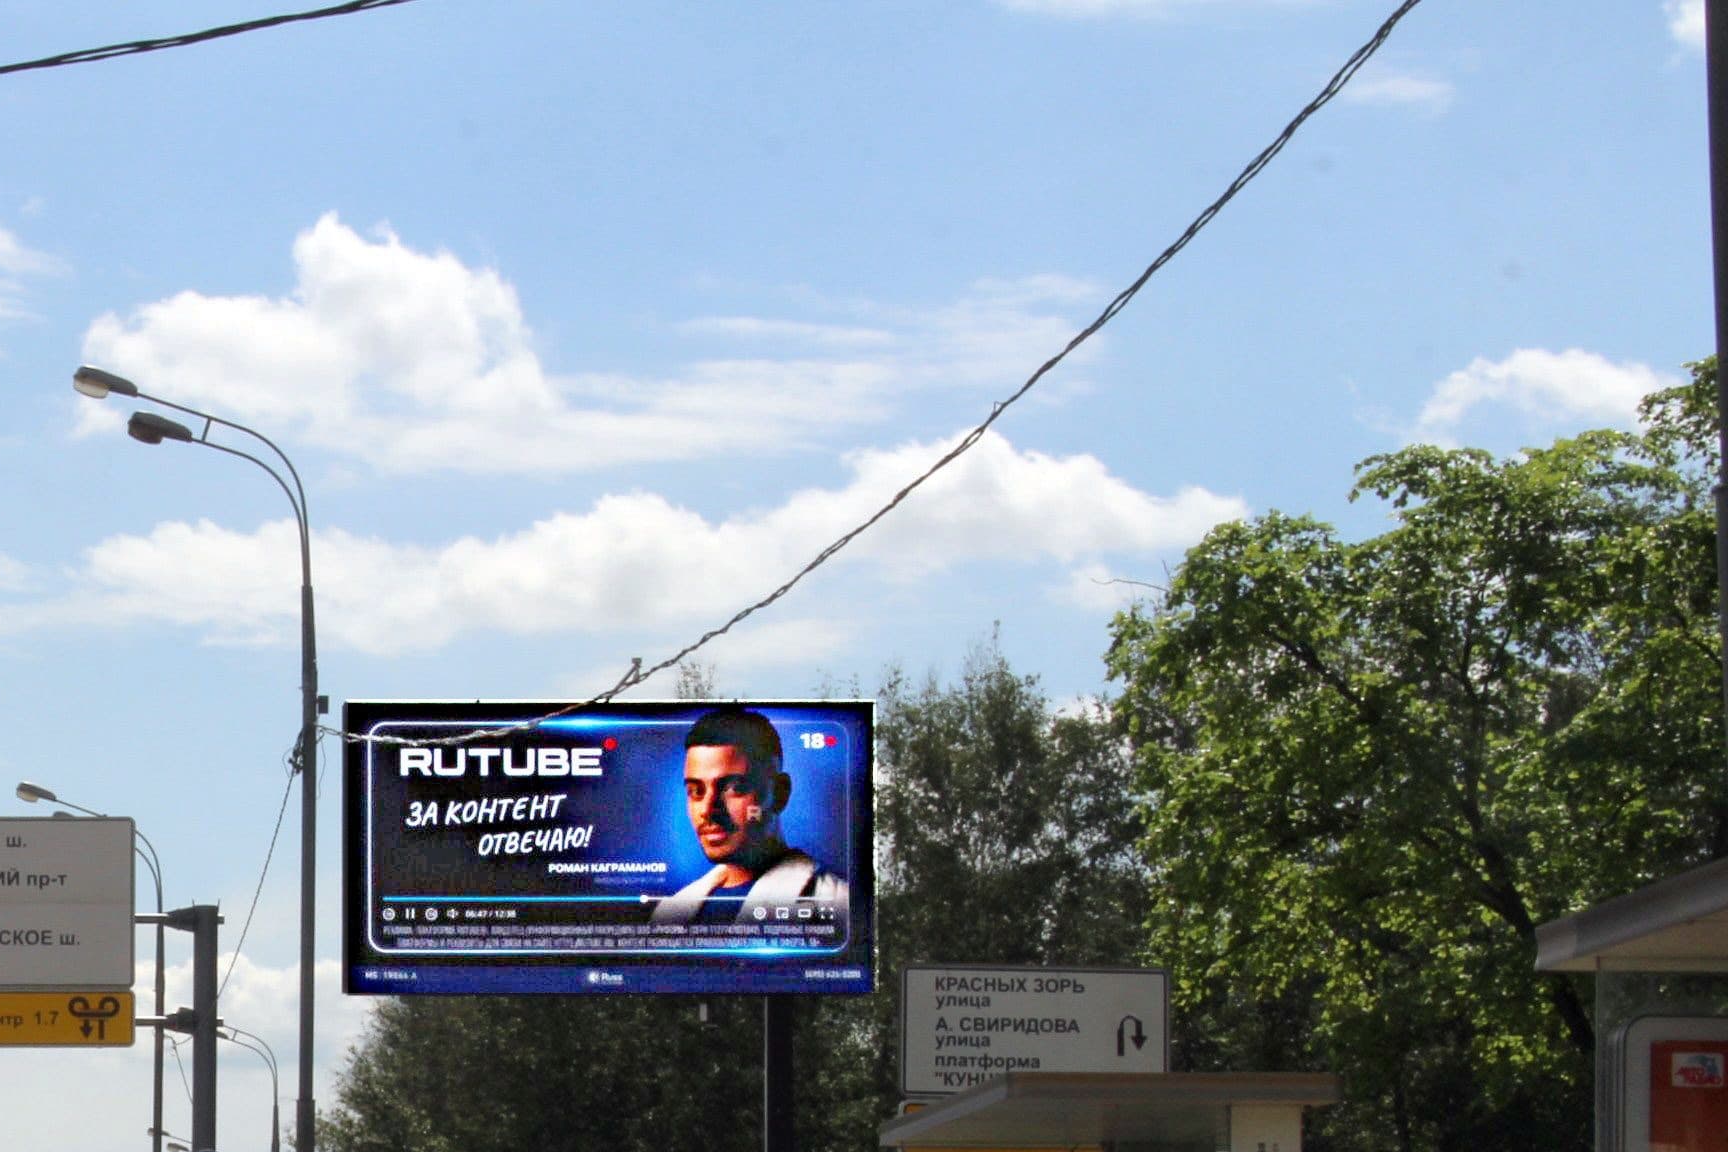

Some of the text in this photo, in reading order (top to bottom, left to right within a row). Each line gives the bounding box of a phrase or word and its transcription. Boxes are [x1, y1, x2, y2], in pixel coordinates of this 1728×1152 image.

[399, 747, 603, 777] RUTUBE
[405, 793, 567, 827] ЗА КОНТЕНТ
[6, 836, 28, 849] ш.
[478, 825, 594, 856] ОТВЕЧАЮ!
[548, 862, 666, 873] РОМАН КАГРАМАНОВ
[27, 873, 67, 891] пр-т
[59, 934, 80, 946] ш.
[934, 976, 1085, 993] КРАСНЫХ ЗОРЬ
[935, 994, 991, 1009] улица
[35, 1011, 59, 1025] 1.7
[935, 1016, 1080, 1035] А. СВИРИДОВА
[935, 1034, 991, 1049] улица
[934, 1053, 1041, 1071] платформа
